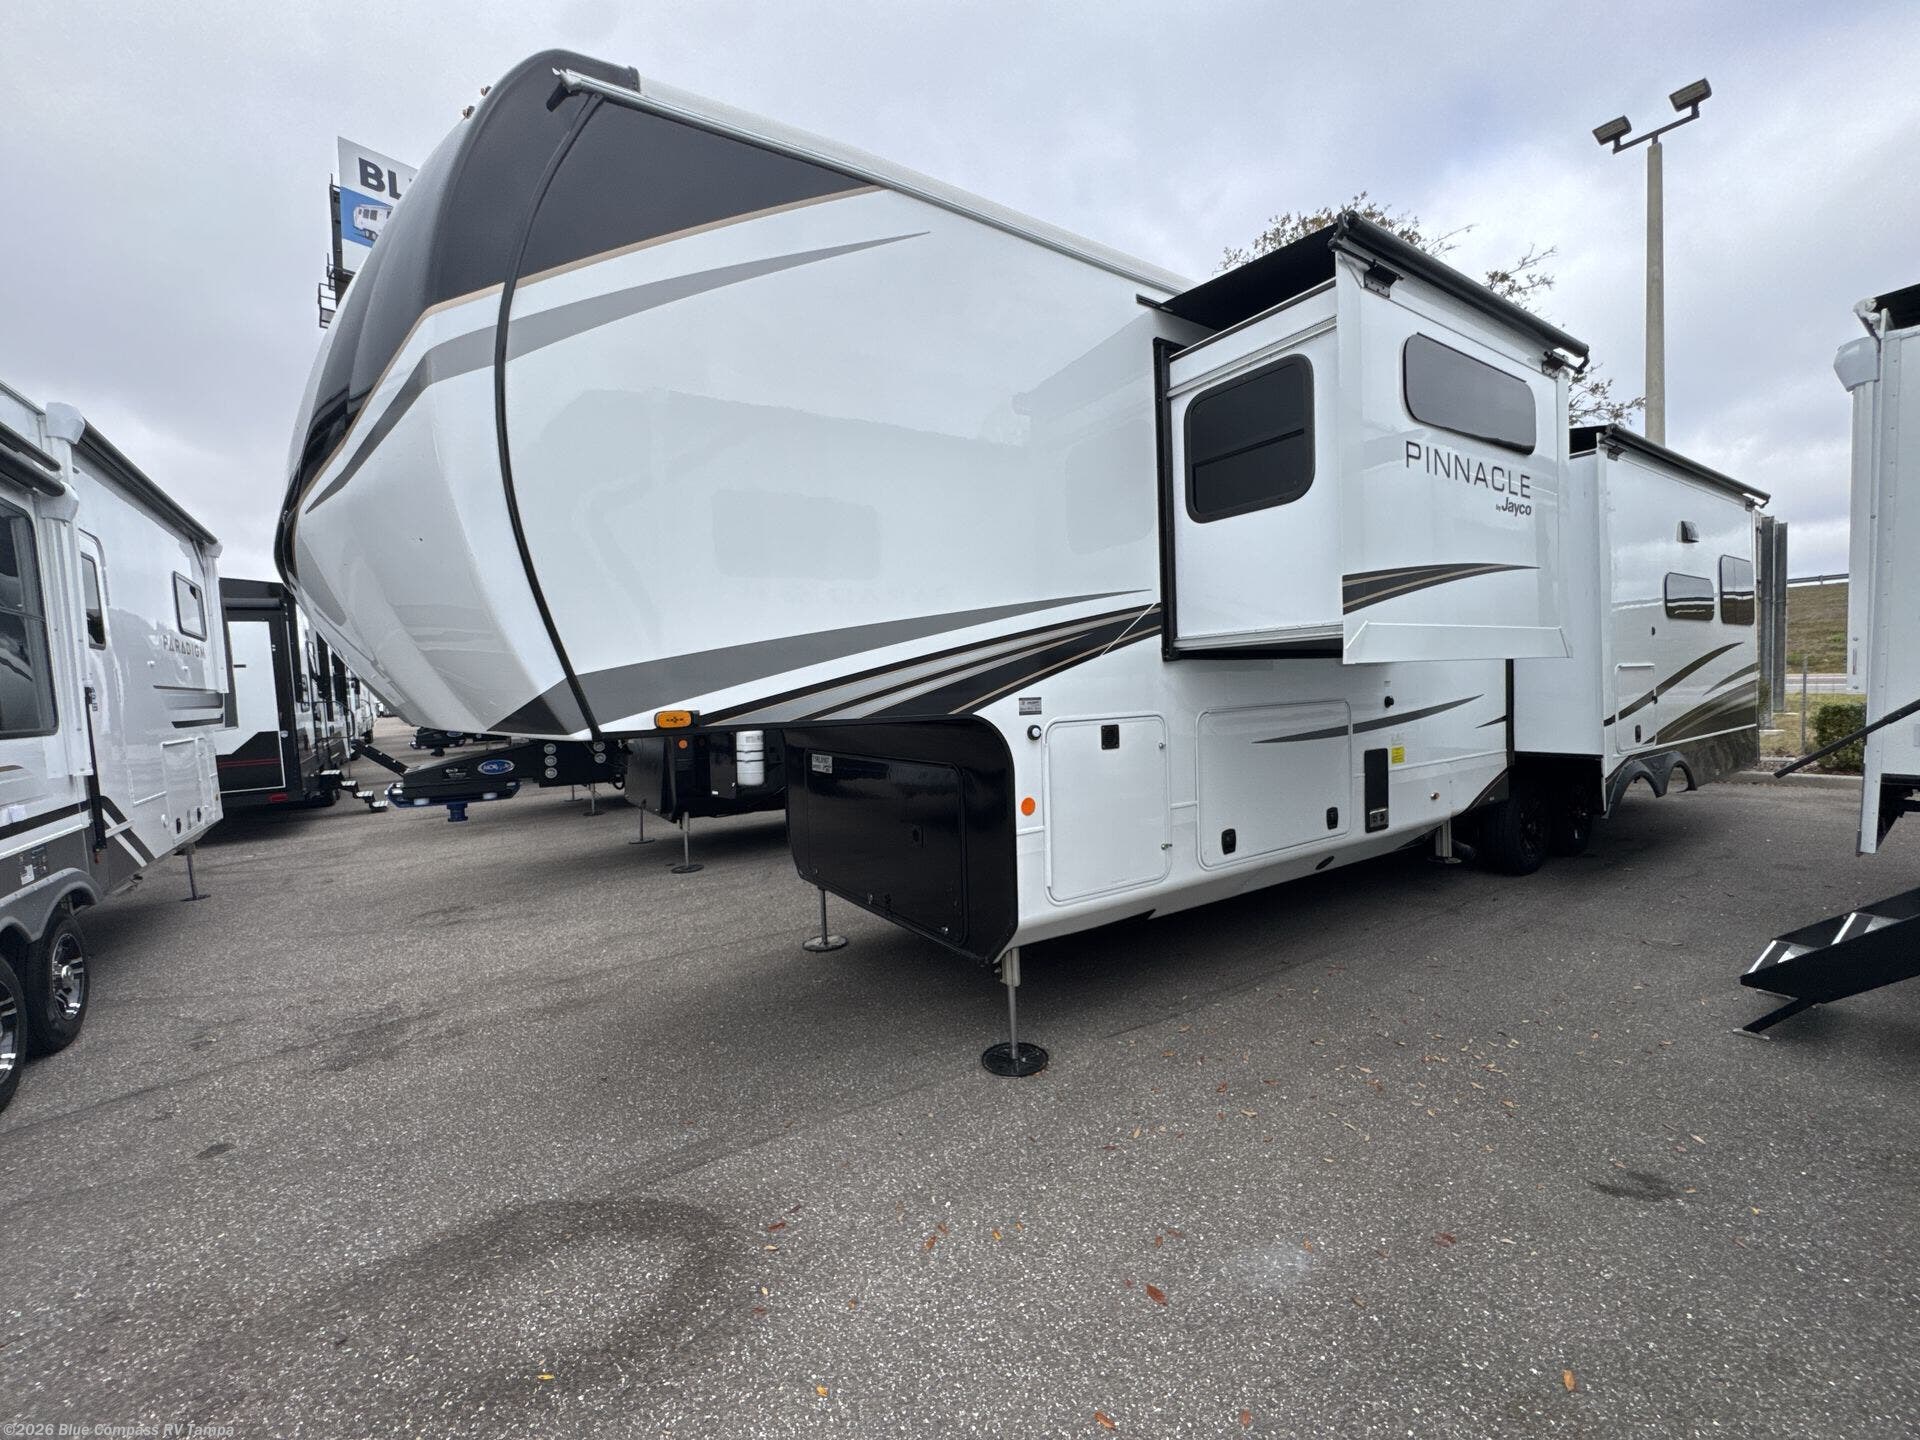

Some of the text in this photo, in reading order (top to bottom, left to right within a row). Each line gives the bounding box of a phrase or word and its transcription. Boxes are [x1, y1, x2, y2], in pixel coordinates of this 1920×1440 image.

[358, 157, 413, 200] BL
[1406, 440, 1531, 499] PINNACLE
[1502, 497, 1531, 517] Jayco
[162, 635, 206, 659] PARADIGM
